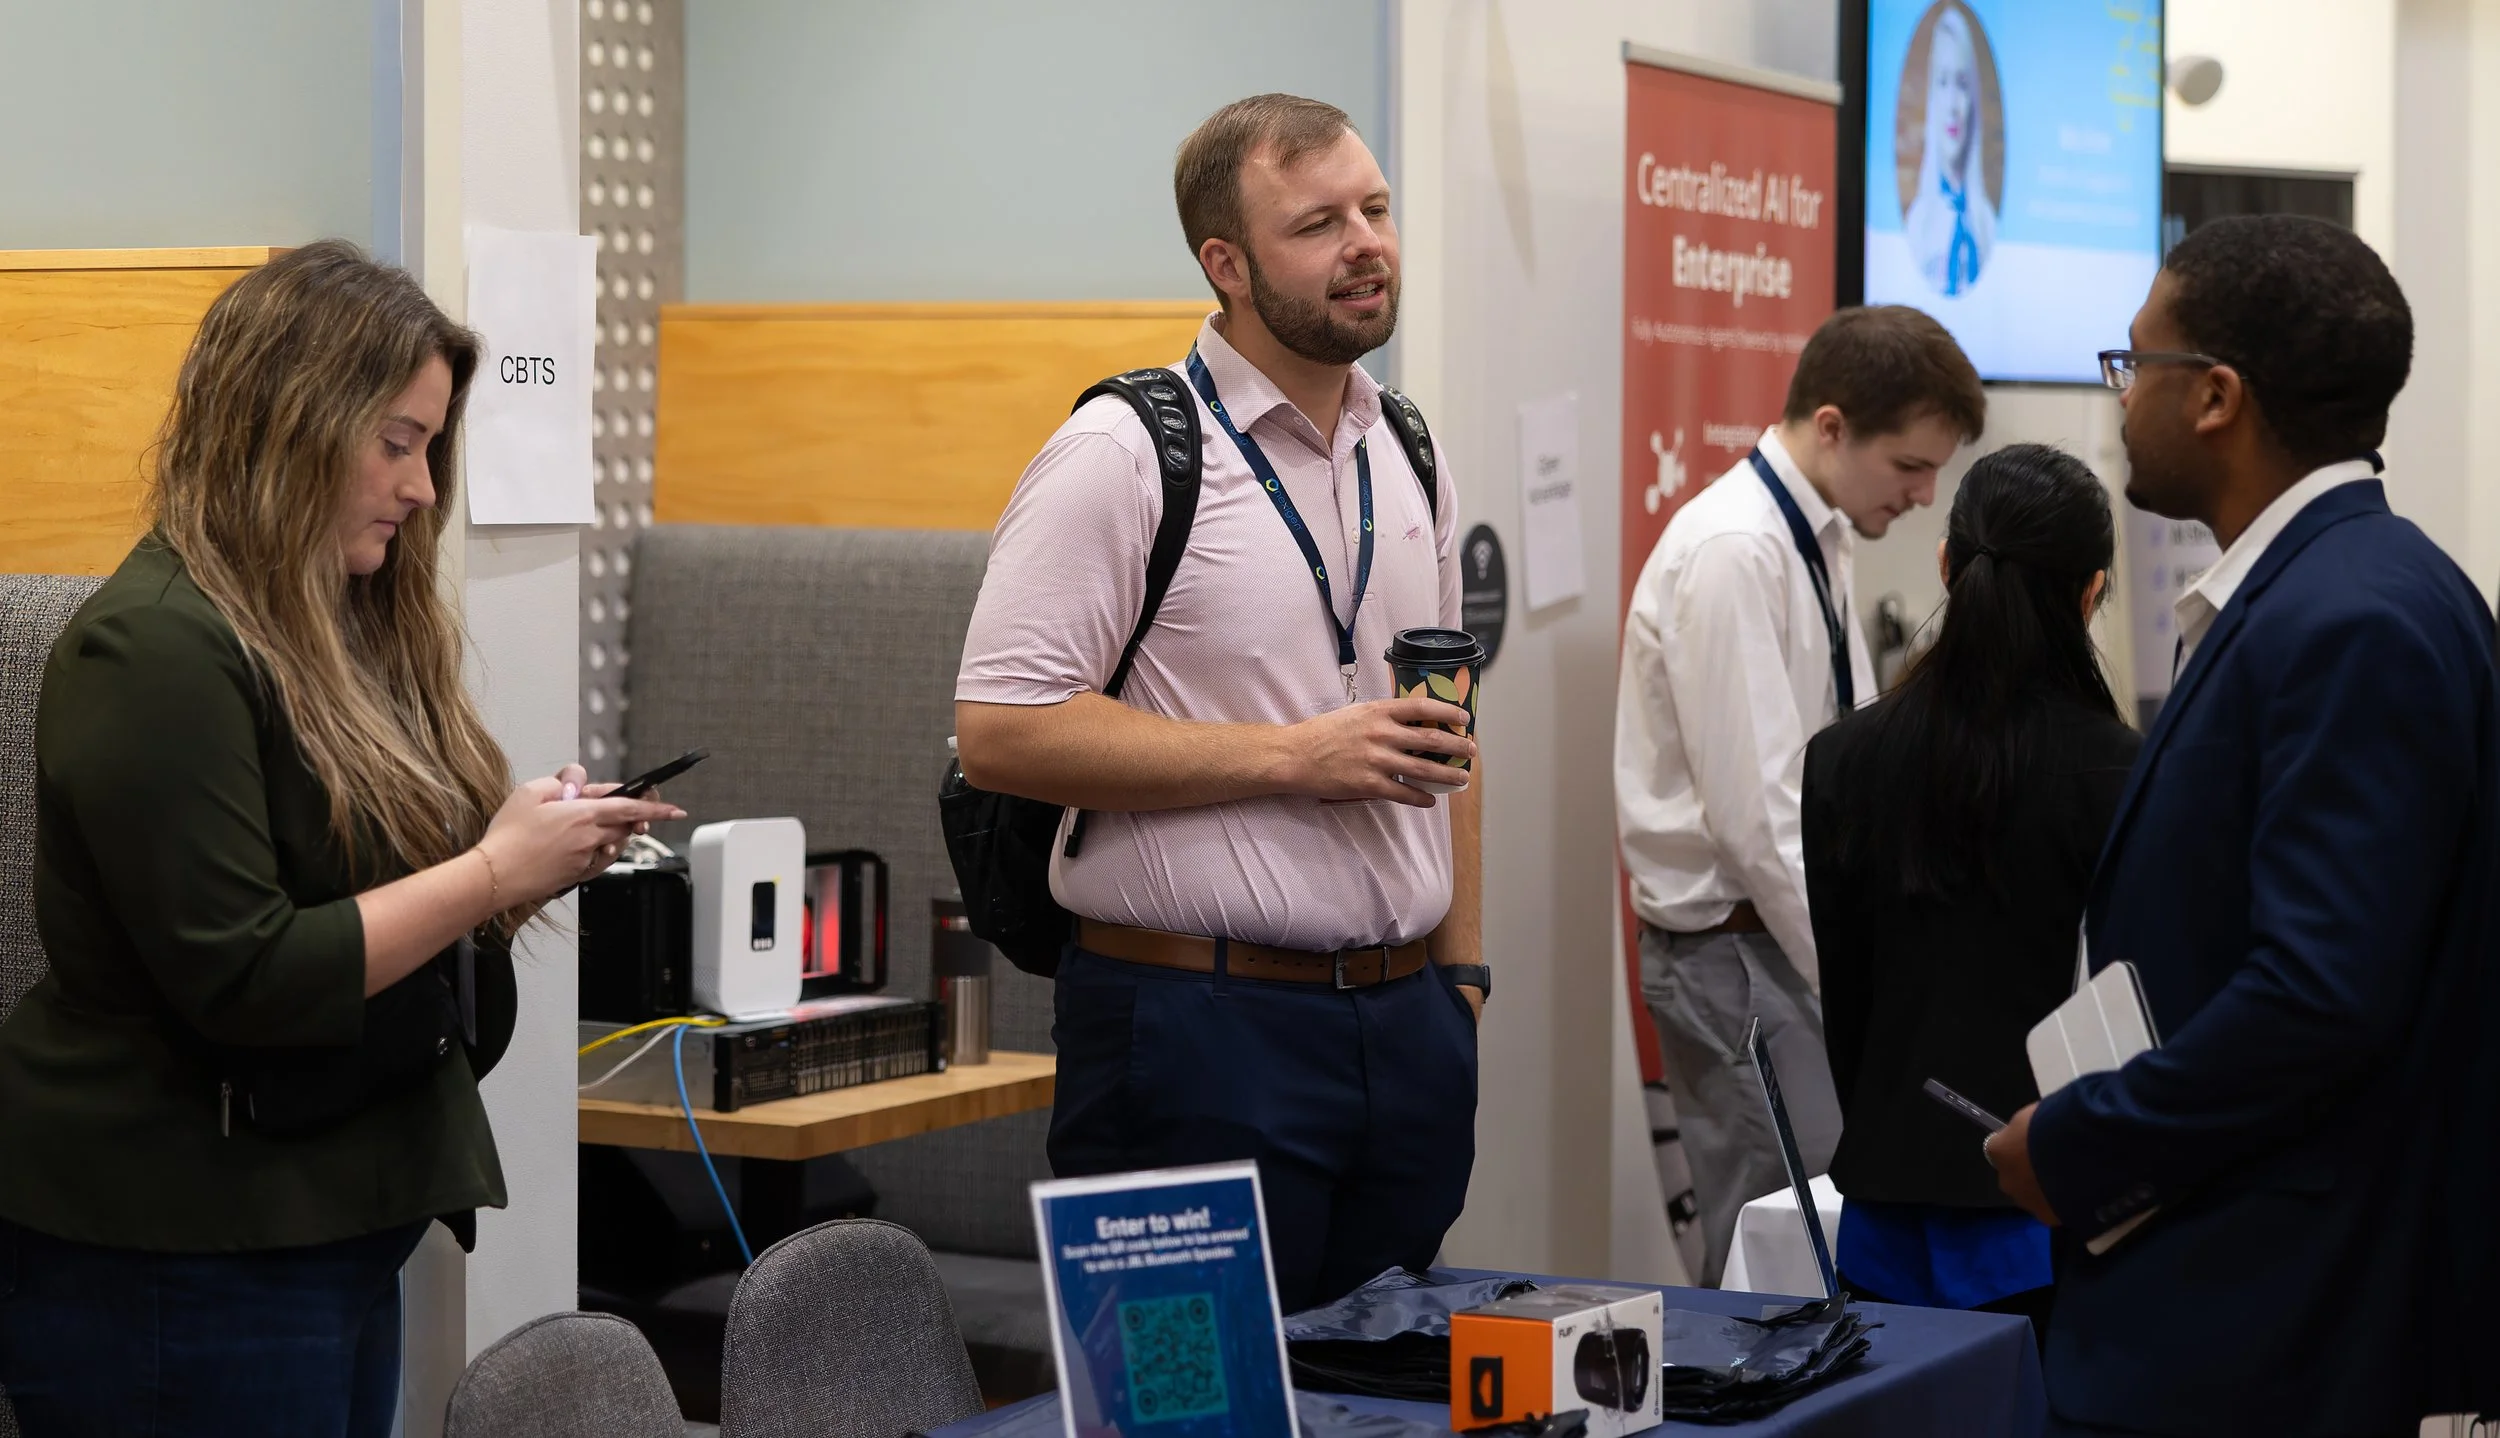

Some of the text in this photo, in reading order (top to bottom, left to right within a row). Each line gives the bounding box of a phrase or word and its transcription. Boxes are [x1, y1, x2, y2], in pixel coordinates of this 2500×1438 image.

[1636, 152, 1825, 230] Centralized AI for
[1672, 234, 1793, 308] Enterprise
[500, 355, 556, 386] CBTS
[1273, 489, 1303, 532] nexigen
[1095, 1206, 1212, 1240] Enter to win!
[1062, 1227, 1250, 1260] Scan the QR code below to be entered
[1084, 1259, 1098, 1274] to
[1098, 1257, 1116, 1272] win
[1145, 1249, 1192, 1267] Bluetooth
